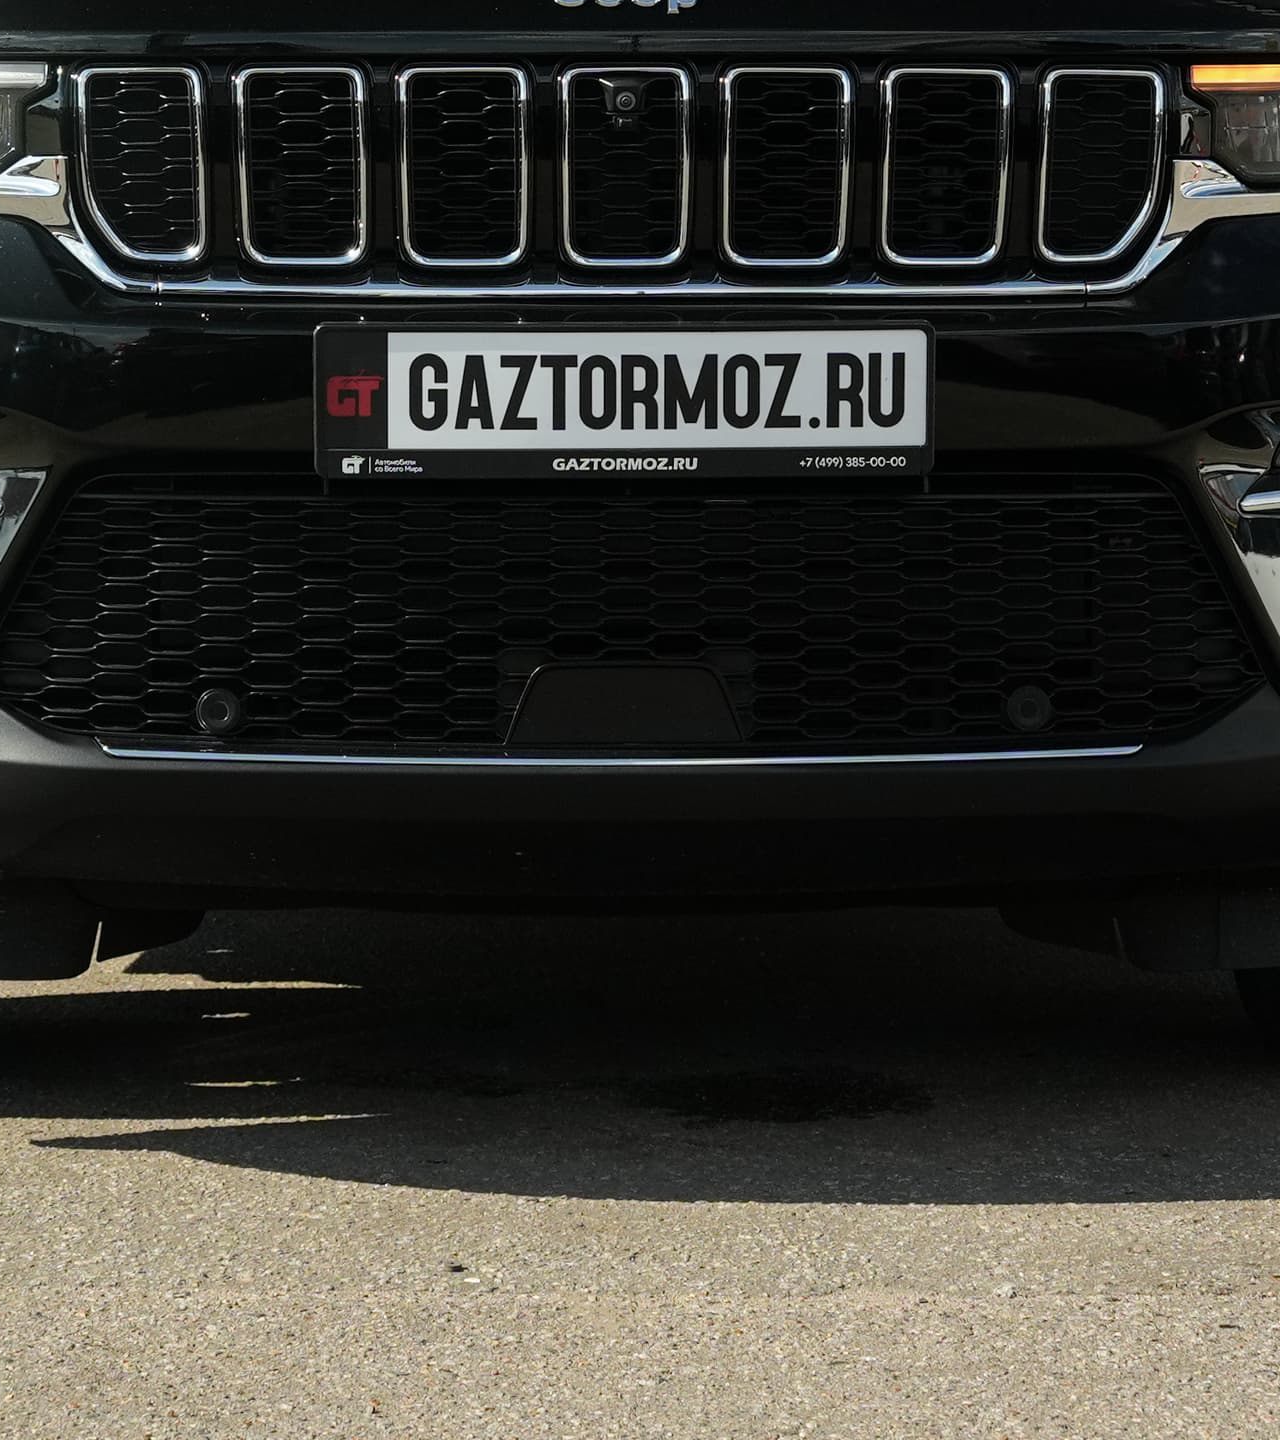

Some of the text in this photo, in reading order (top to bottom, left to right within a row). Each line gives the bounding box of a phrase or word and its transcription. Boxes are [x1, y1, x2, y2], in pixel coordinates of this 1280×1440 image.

[326, 370, 384, 418] GT
[408, 351, 906, 432] GAZTORMOZ.RU
[552, 457, 699, 471] GAZTORMOZ.RU
[799, 455, 907, 470] +7 (499) 385-00-00
